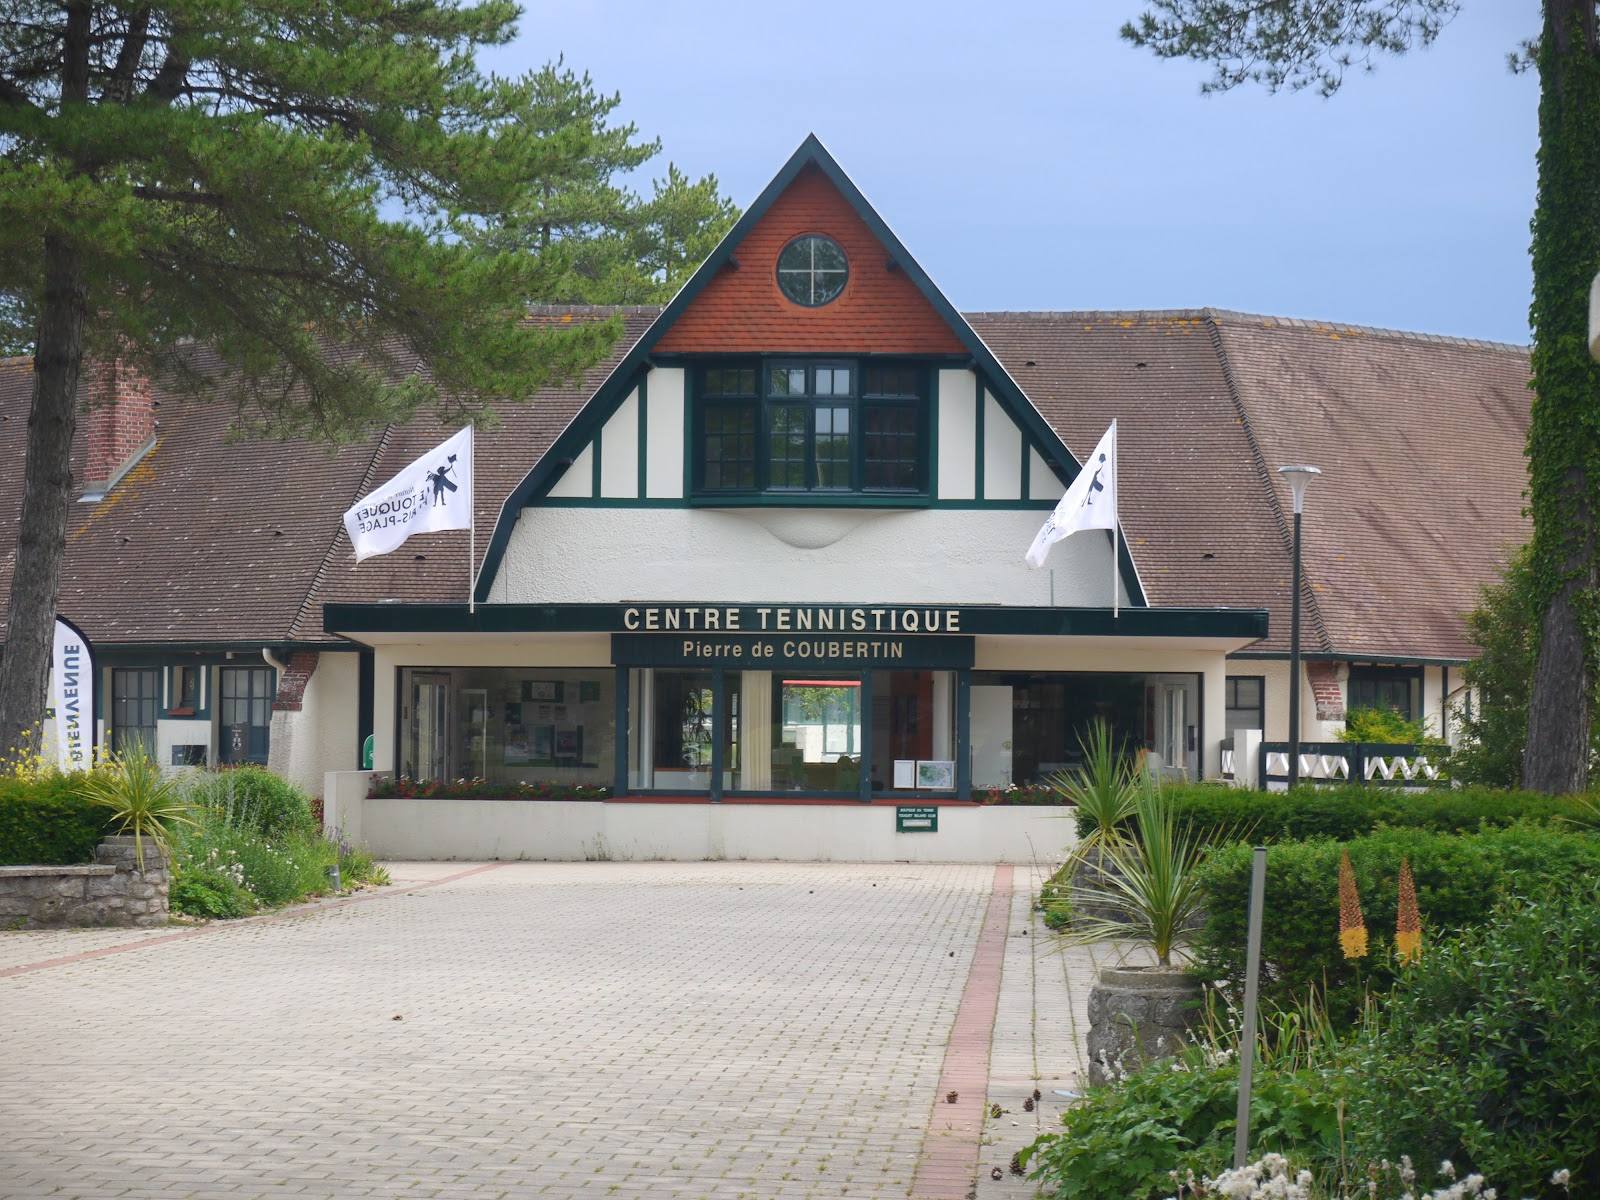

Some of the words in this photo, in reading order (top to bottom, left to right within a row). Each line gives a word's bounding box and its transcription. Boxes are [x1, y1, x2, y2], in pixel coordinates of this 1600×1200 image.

[623, 607, 740, 630] CENTRE
[756, 608, 960, 632] TENNISTIQUE
[683, 640, 743, 657] Pierre
[751, 641, 774, 657] de
[783, 641, 903, 658] COUBERTIN
